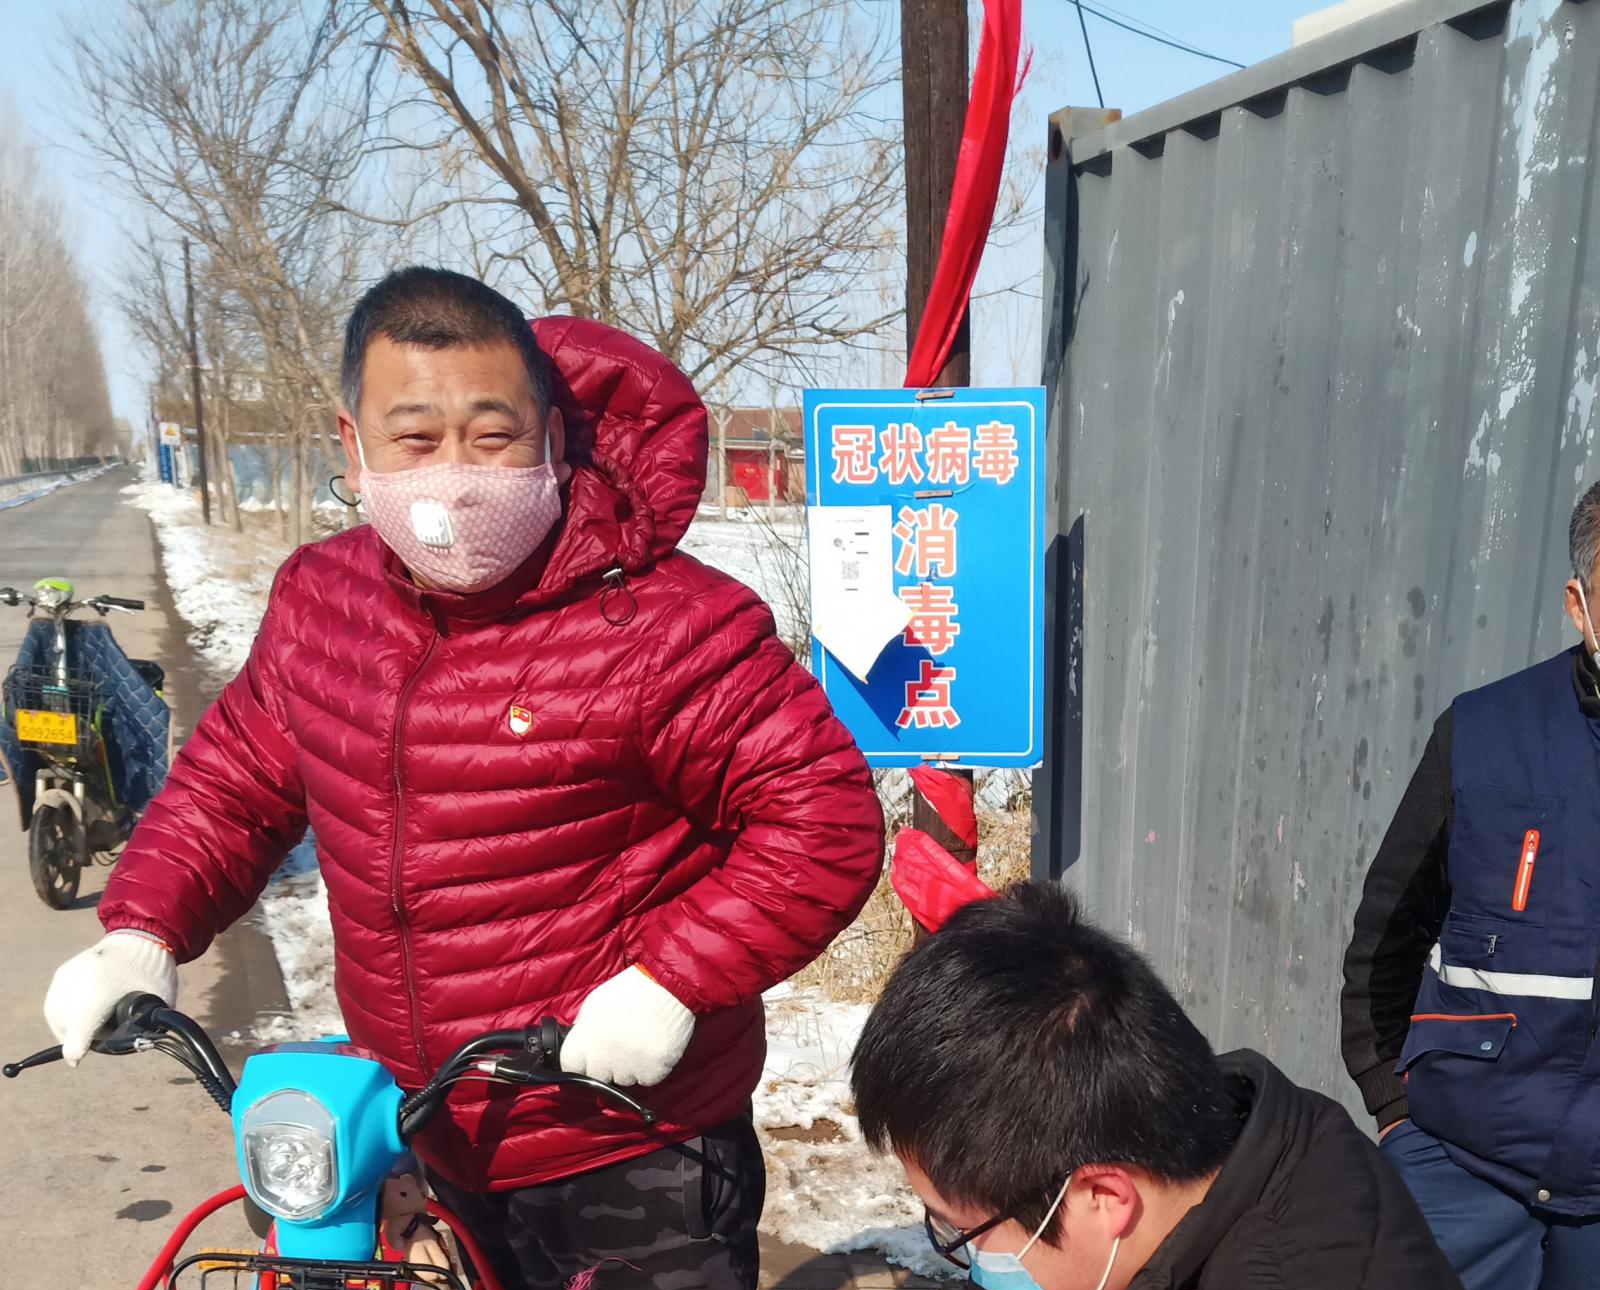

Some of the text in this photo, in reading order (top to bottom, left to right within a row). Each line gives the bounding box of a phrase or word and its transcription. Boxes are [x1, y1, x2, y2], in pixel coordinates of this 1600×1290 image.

[832, 420, 1019, 484] 冠状病毒
[893, 504, 961, 728] 消毒点
